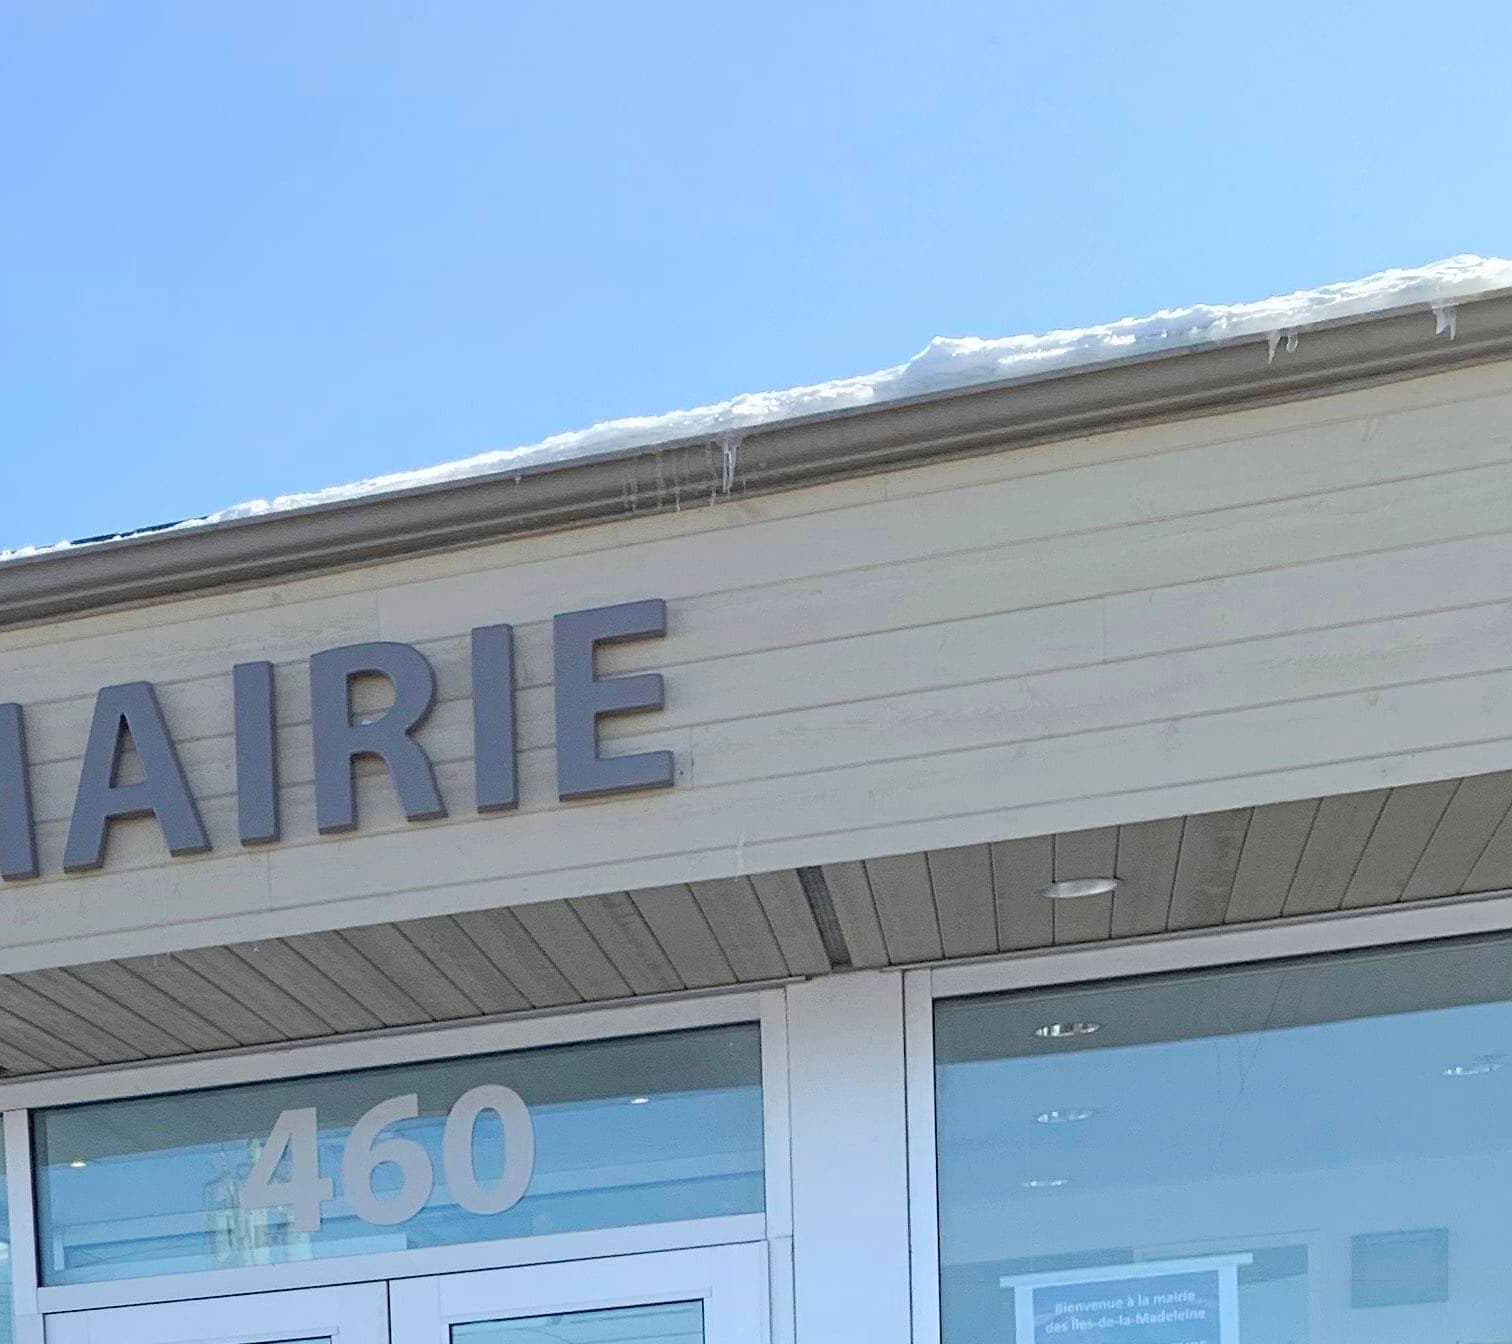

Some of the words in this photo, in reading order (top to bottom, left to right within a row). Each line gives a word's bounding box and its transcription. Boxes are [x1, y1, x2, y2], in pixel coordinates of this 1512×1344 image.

[238, 1083, 535, 1232] 460
[1055, 1299, 1123, 1315] Bienvenue
[1138, 1293, 1150, 1307] la
[1153, 1290, 1196, 1305] mairie
[1045, 1320, 1068, 1334] des
